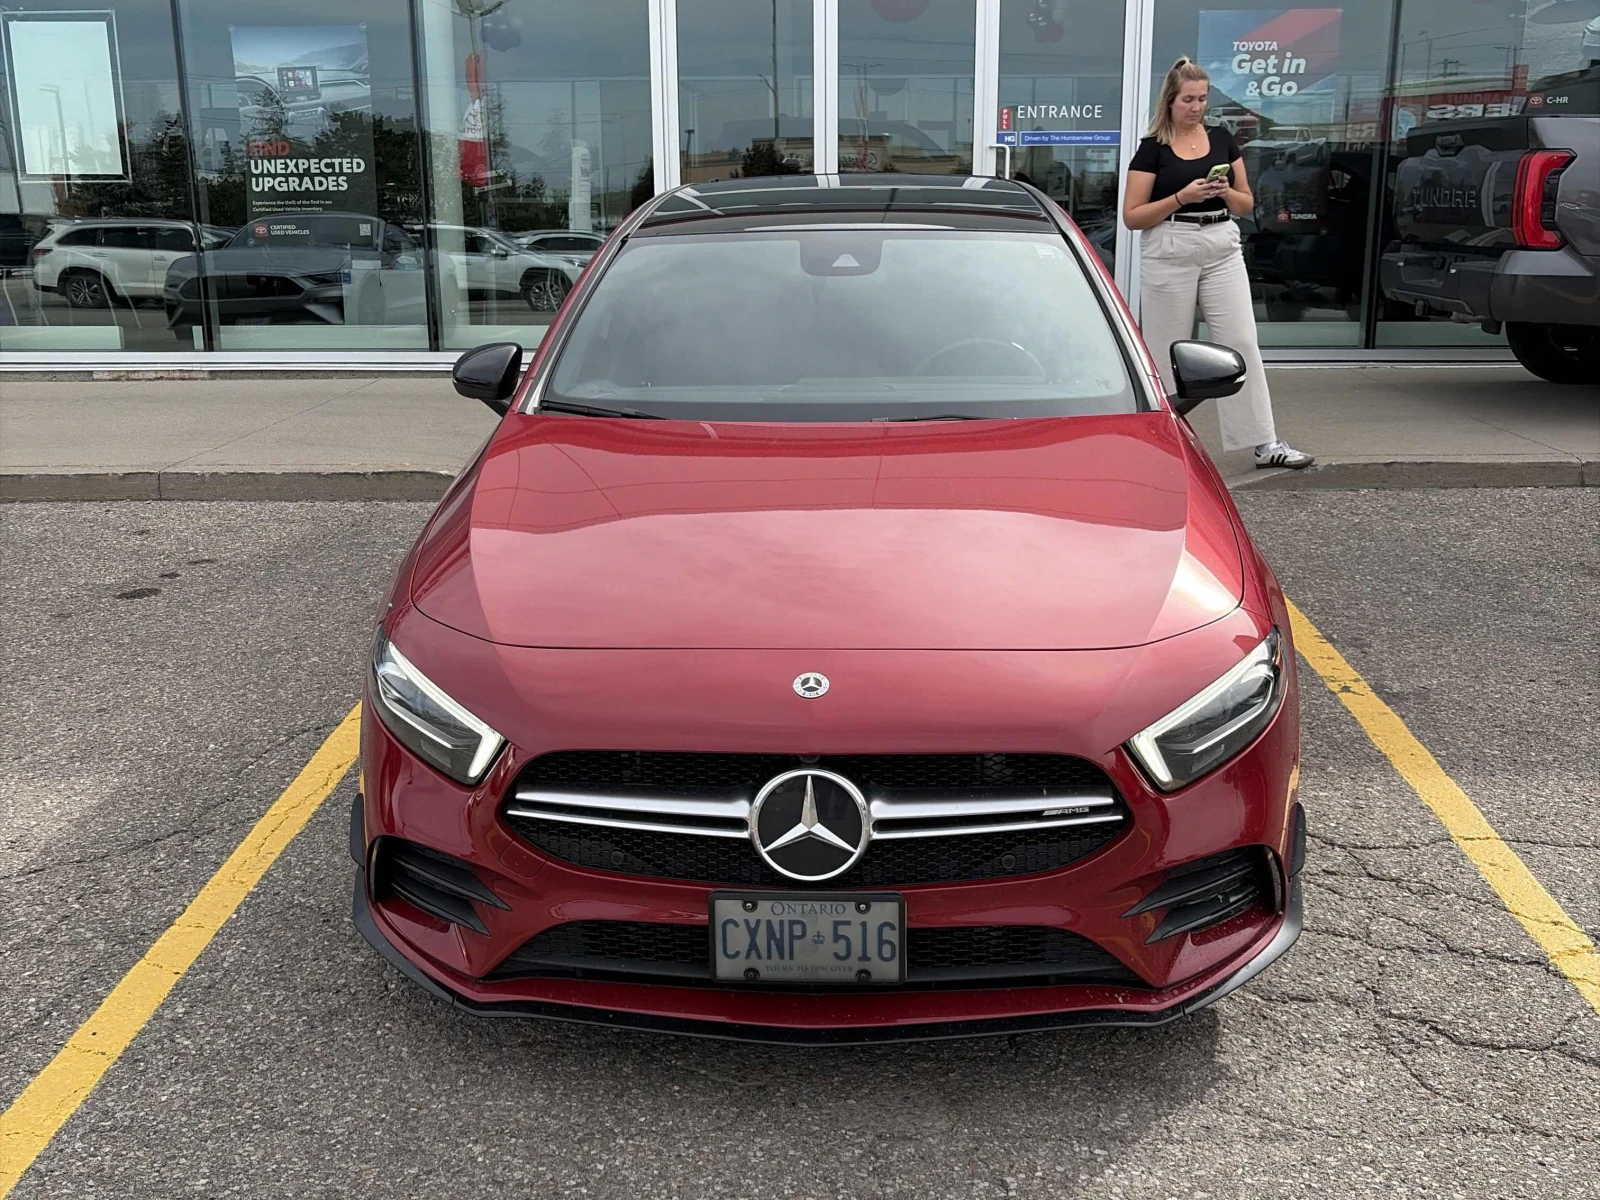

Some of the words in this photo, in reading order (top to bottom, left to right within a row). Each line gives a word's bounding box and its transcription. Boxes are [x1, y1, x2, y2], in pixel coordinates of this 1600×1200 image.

[1232, 41, 1278, 52] TOYOTA
[1231, 53, 1279, 74] Get
[1282, 51, 1307, 74] in
[1245, 75, 1298, 97] &Go
[1449, 94, 1501, 104] TUNDRA
[1546, 96, 1569, 104] C-HR
[1017, 104, 1103, 119] ENTRANCE
[1093, 134, 1111, 142] Group
[248, 141, 291, 156] FIND
[250, 158, 366, 174] UNEXPECTED
[251, 176, 349, 192] UPGRADES
[1411, 186, 1478, 208] TUNDRA
[770, 901, 846, 916] ONTARIO
[721, 918, 807, 961] CXNP
[832, 920, 897, 962] 516
[811, 965, 854, 973] DISCOVER
